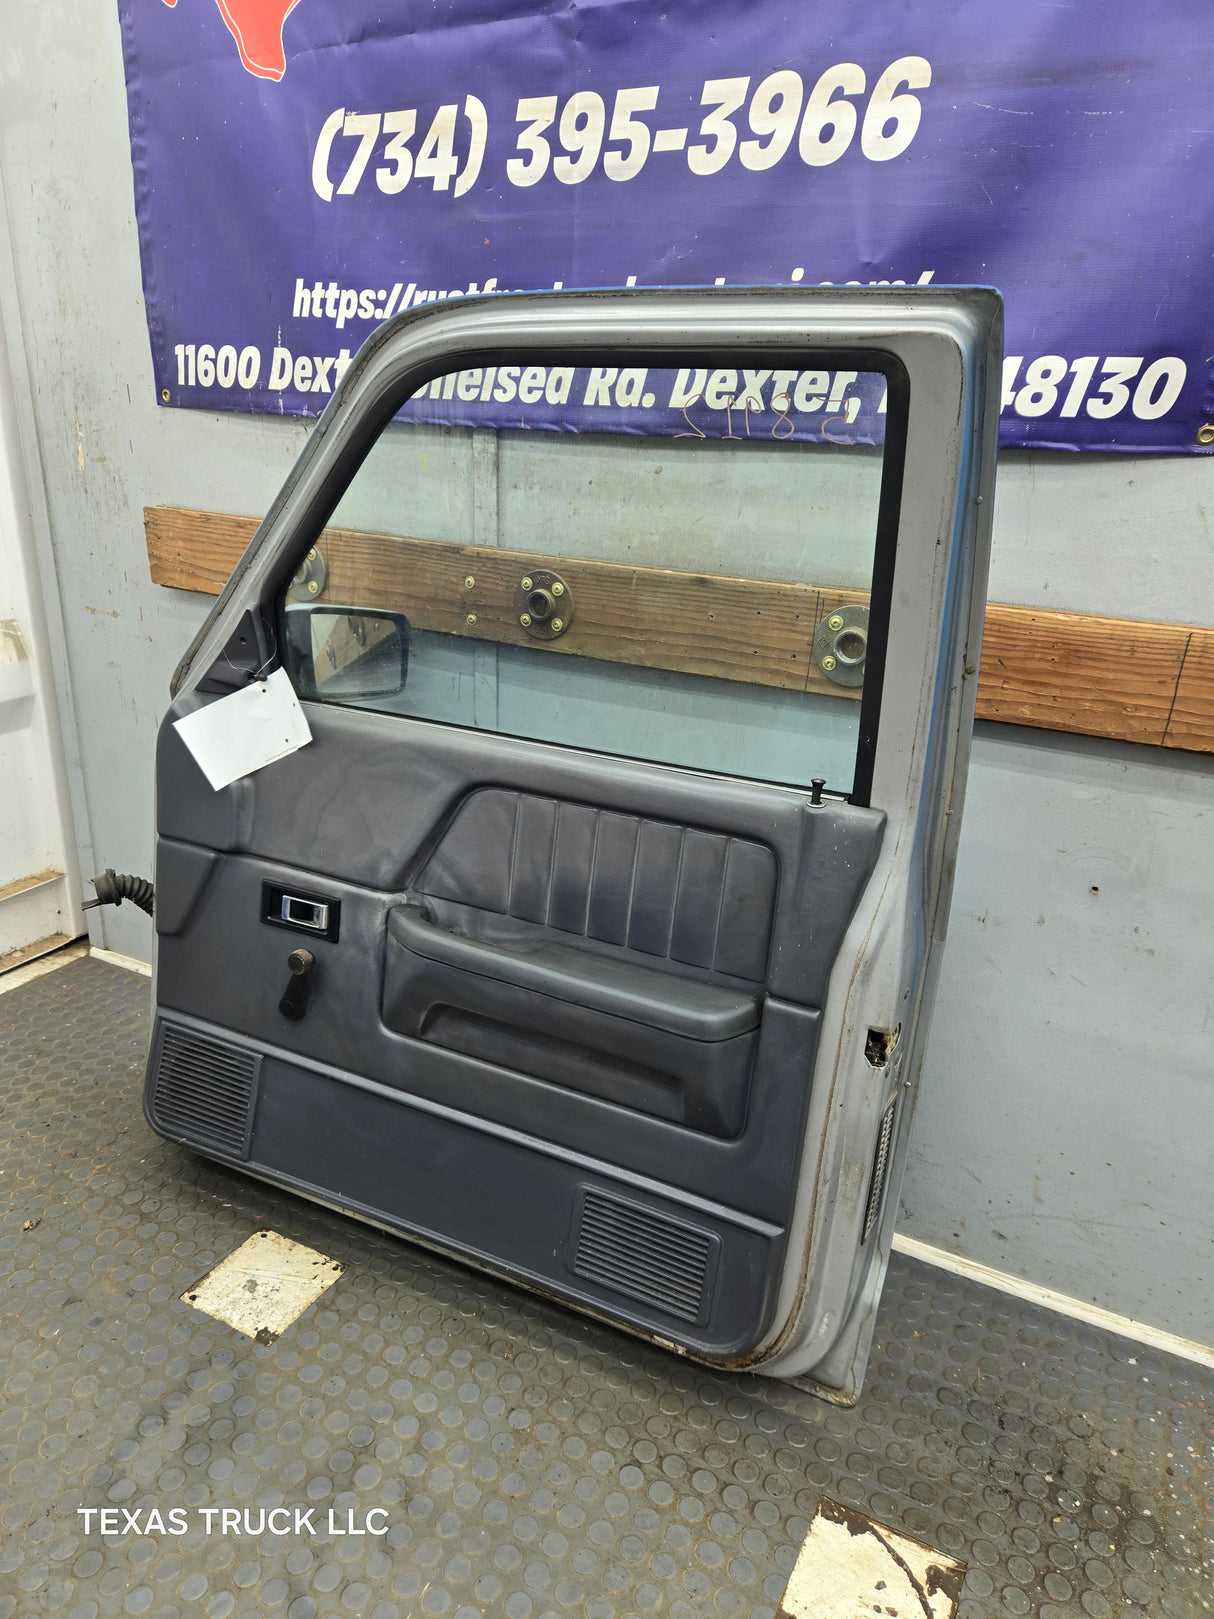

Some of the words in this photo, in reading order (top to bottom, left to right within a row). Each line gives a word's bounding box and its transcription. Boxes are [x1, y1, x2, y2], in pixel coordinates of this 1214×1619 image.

[312, 94, 488, 202] (734)
[506, 55, 932, 187] 395-3966
[174, 344, 261, 389] 11600
[268, 347, 354, 394] Dext
[668, 369, 861, 424] Dexter,
